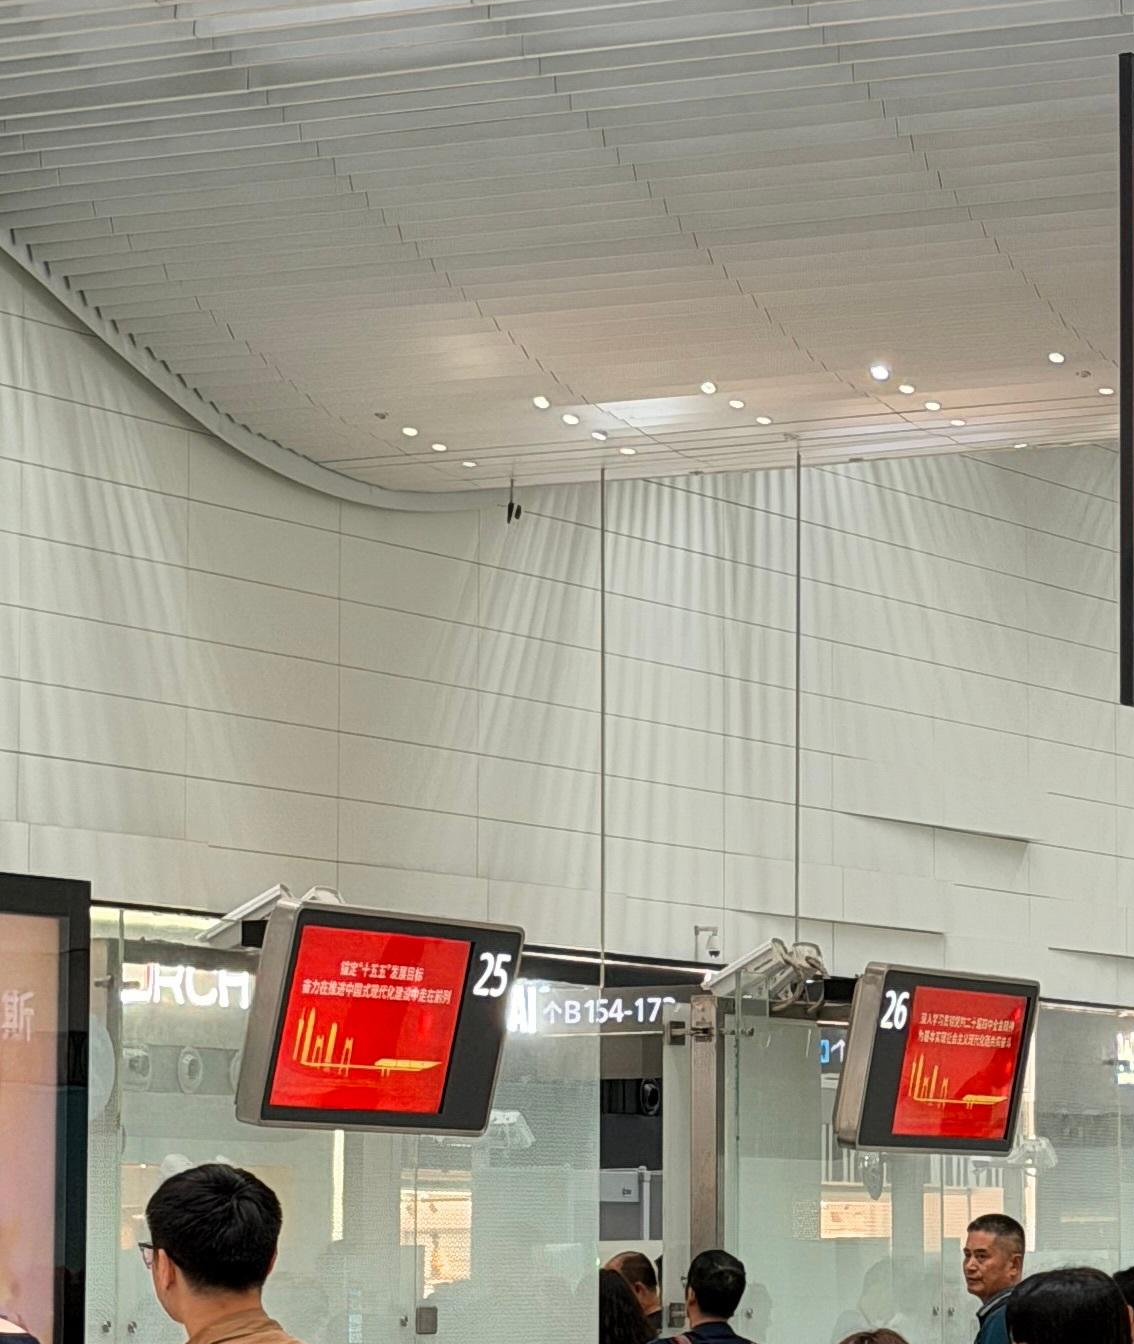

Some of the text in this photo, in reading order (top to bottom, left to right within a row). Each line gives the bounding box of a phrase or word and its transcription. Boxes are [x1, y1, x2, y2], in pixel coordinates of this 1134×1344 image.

[120, 962, 251, 1010] RCH
[473, 952, 512, 997] 25
[880, 989, 910, 1030] 26
